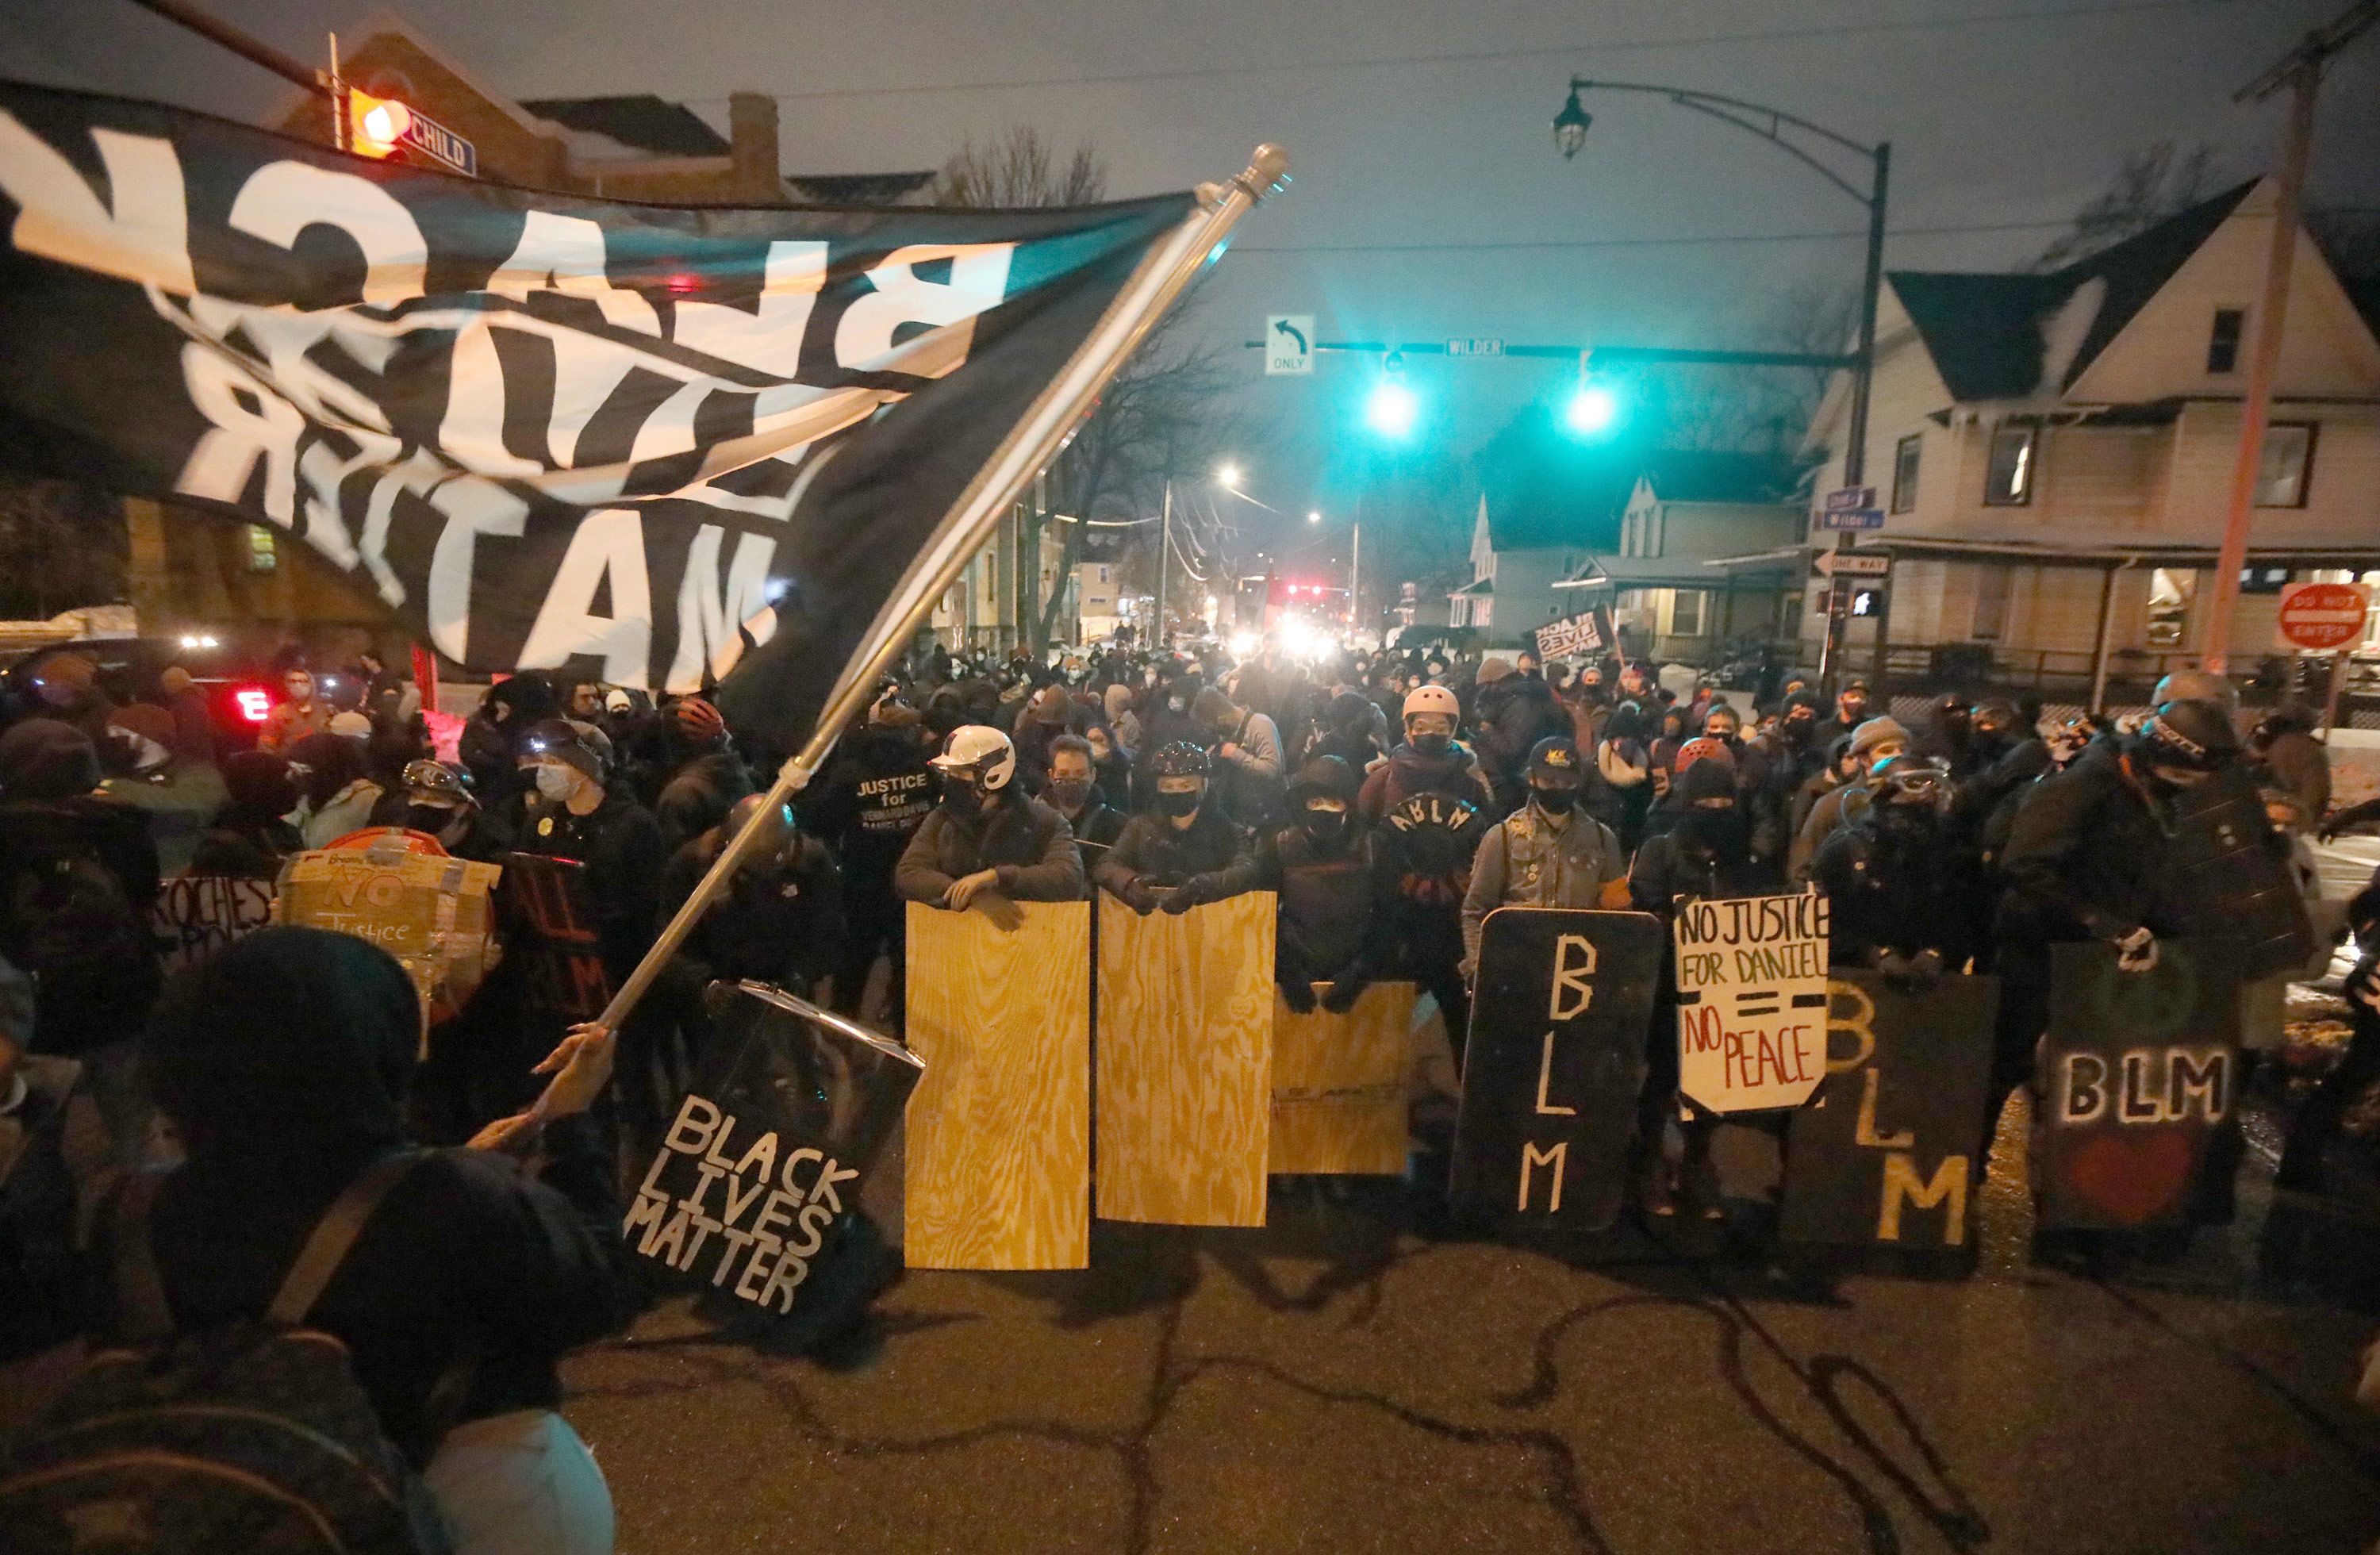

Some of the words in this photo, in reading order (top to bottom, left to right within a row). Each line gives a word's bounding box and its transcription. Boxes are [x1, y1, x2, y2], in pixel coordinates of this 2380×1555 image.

[411, 113, 465, 167] CHILD
[1274, 358, 1306, 369] ONLY
[1449, 340, 1500, 356] WILDER
[1831, 557, 1851, 570] ONE
[1860, 557, 1885, 570] WAY
[2294, 596, 2316, 608] DO
[2323, 595, 2355, 609] NOT
[2293, 624, 2348, 637] ENTER
[857, 774, 927, 797] JUSTICE
[881, 793, 906, 807] for
[322, 864, 405, 909] NO
[1679, 903, 1718, 945] NO
[1722, 894, 1829, 945] JUSTICE
[1682, 952, 1728, 986] FOR
[1734, 941, 1829, 985] DANIEL
[1684, 1004, 1722, 1054] NO
[1724, 1024, 1814, 1089] PEACE
[1517, 933, 1598, 1213] BLM
[2060, 1048, 2231, 1125] BLM
[663, 1093, 860, 1213] BLACK
[639, 1146, 834, 1257] LIVES
[622, 1194, 808, 1315] MATTER
